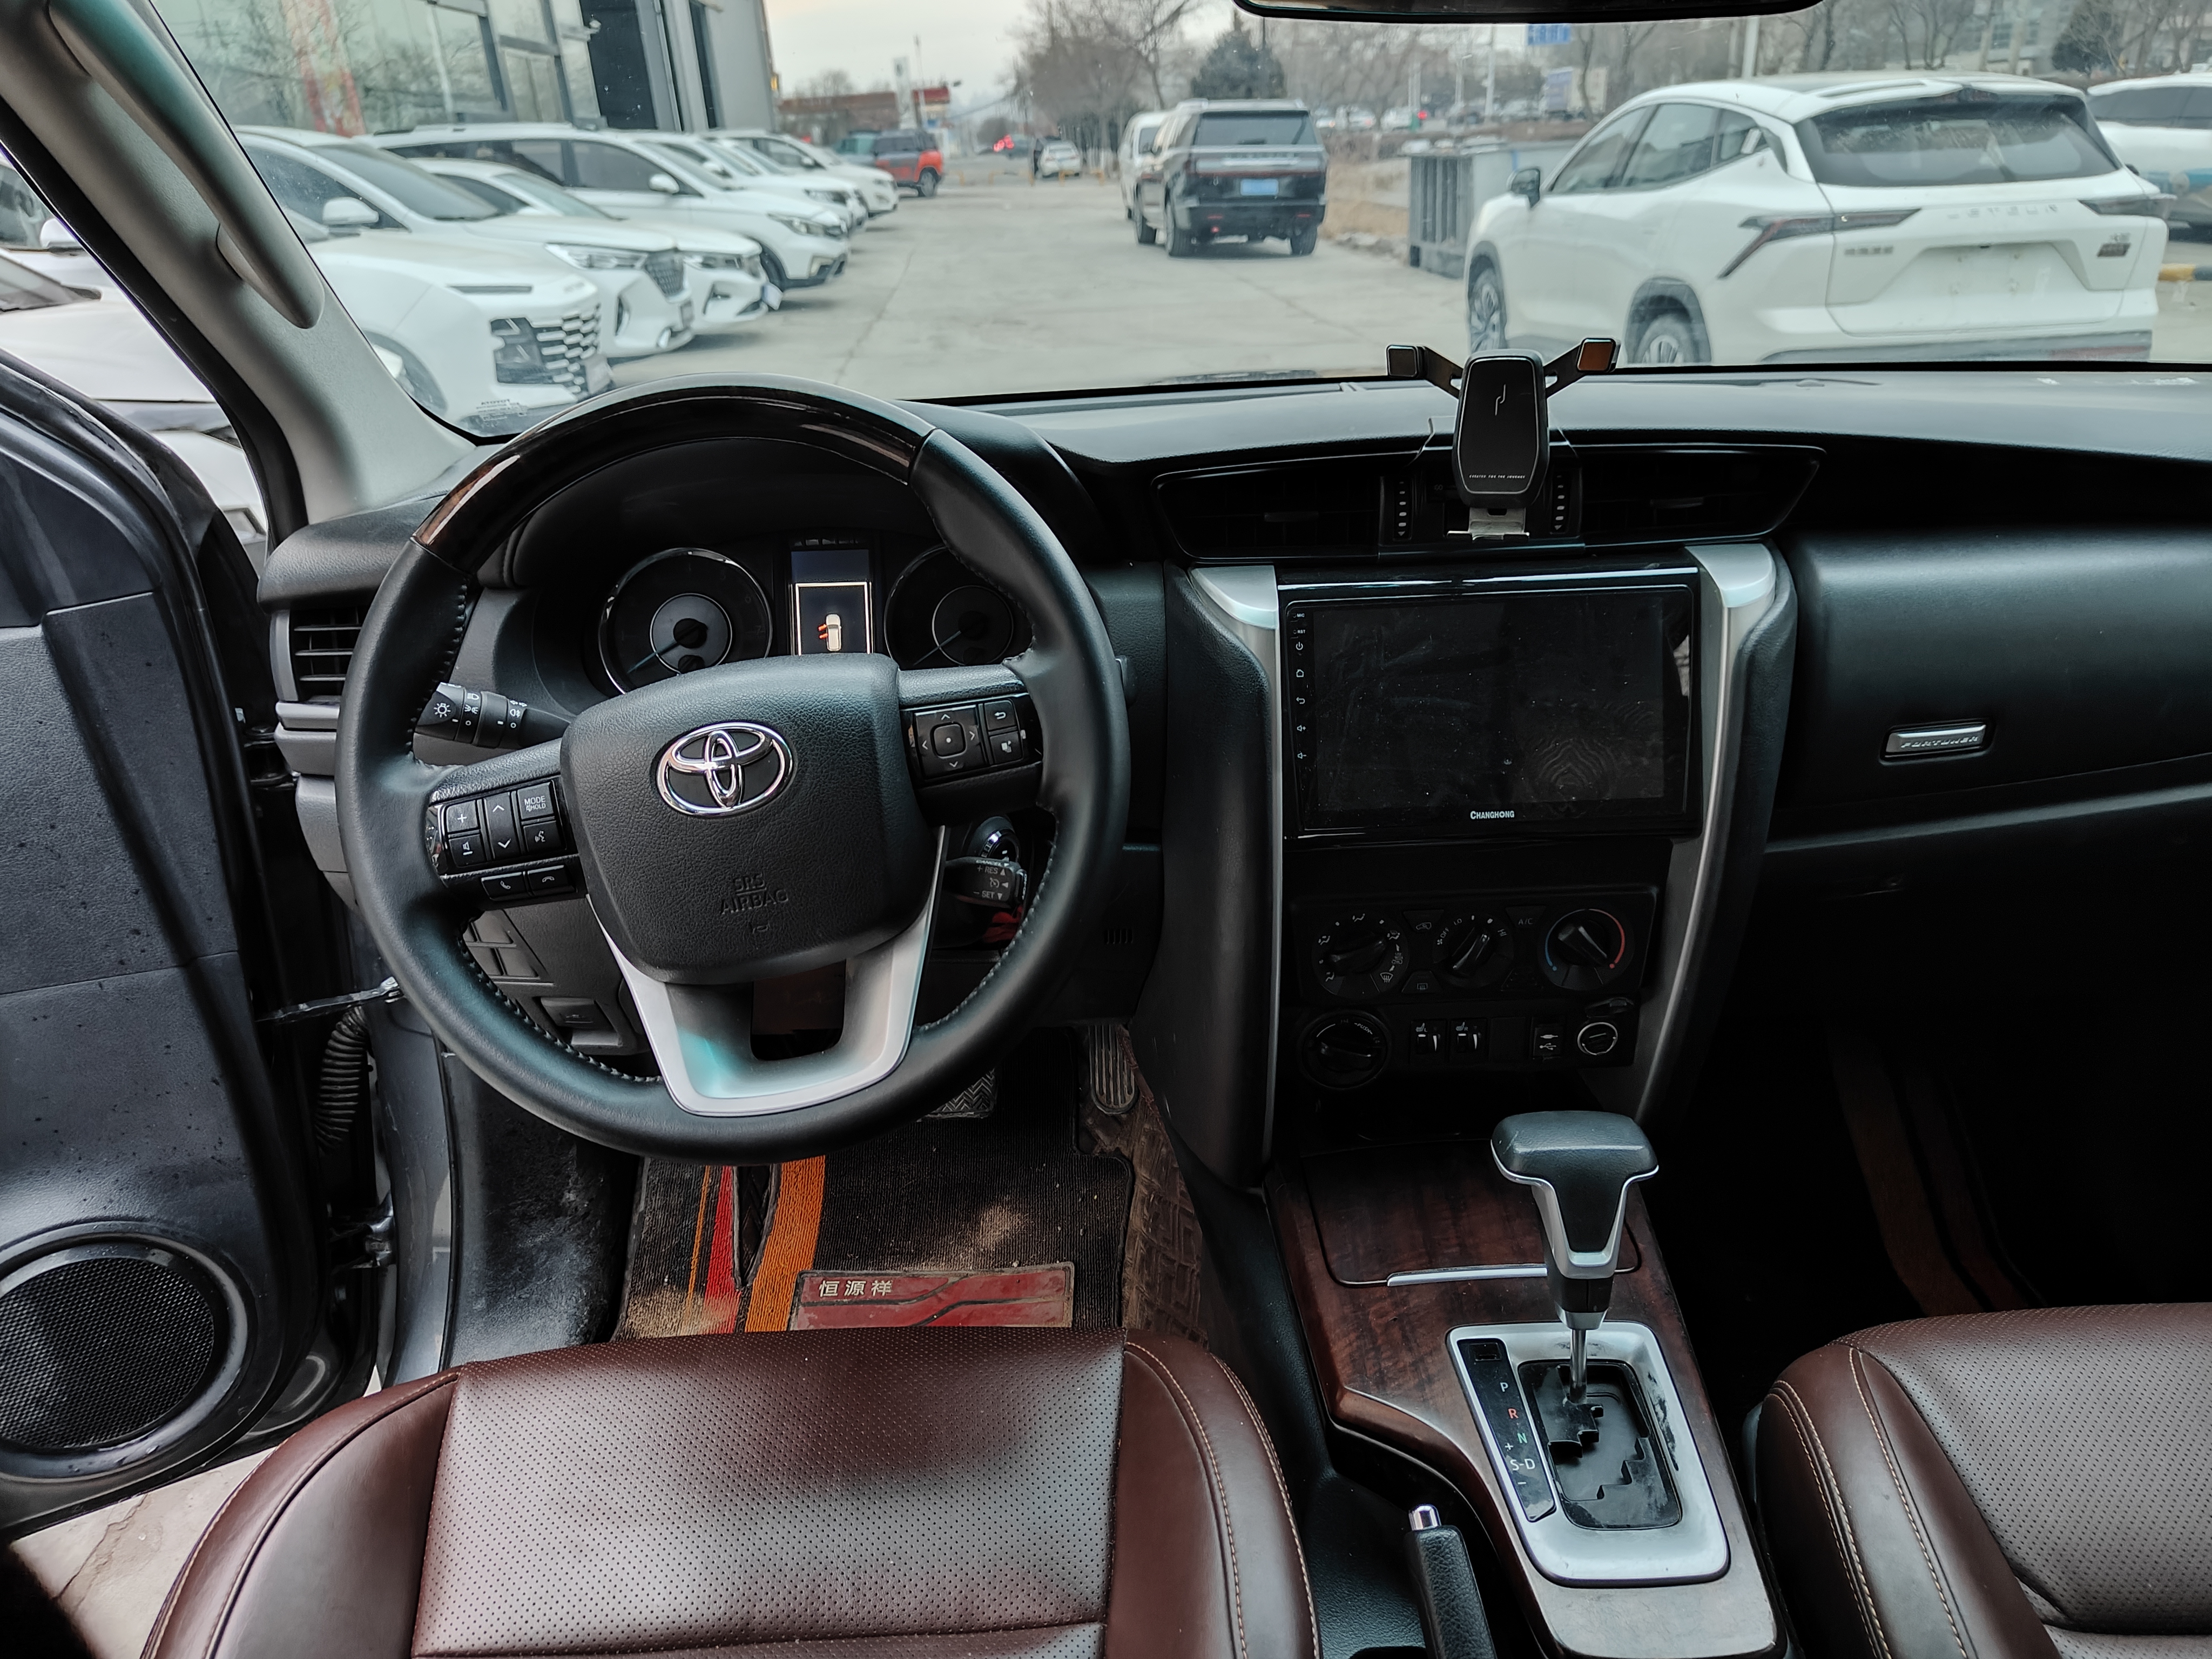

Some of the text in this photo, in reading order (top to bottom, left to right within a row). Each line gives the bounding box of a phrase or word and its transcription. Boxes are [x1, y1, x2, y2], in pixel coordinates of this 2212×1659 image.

[1900, 736, 1980, 748] FORTUNER
[524, 795, 546, 805] MODE
[531, 802, 546, 812] HOLD
[1470, 810, 1515, 820] CHANGHONG
[984, 866, 999, 874] RES
[982, 890, 995, 899] SET
[719, 888, 789, 915] AIRBAG
[1518, 918, 1534, 926] A/C
[818, 1279, 893, 1297] 恒源祥
[1500, 1382, 1508, 1392] P
[1508, 1408, 1519, 1419] R
[1517, 1433, 1528, 1444] N
